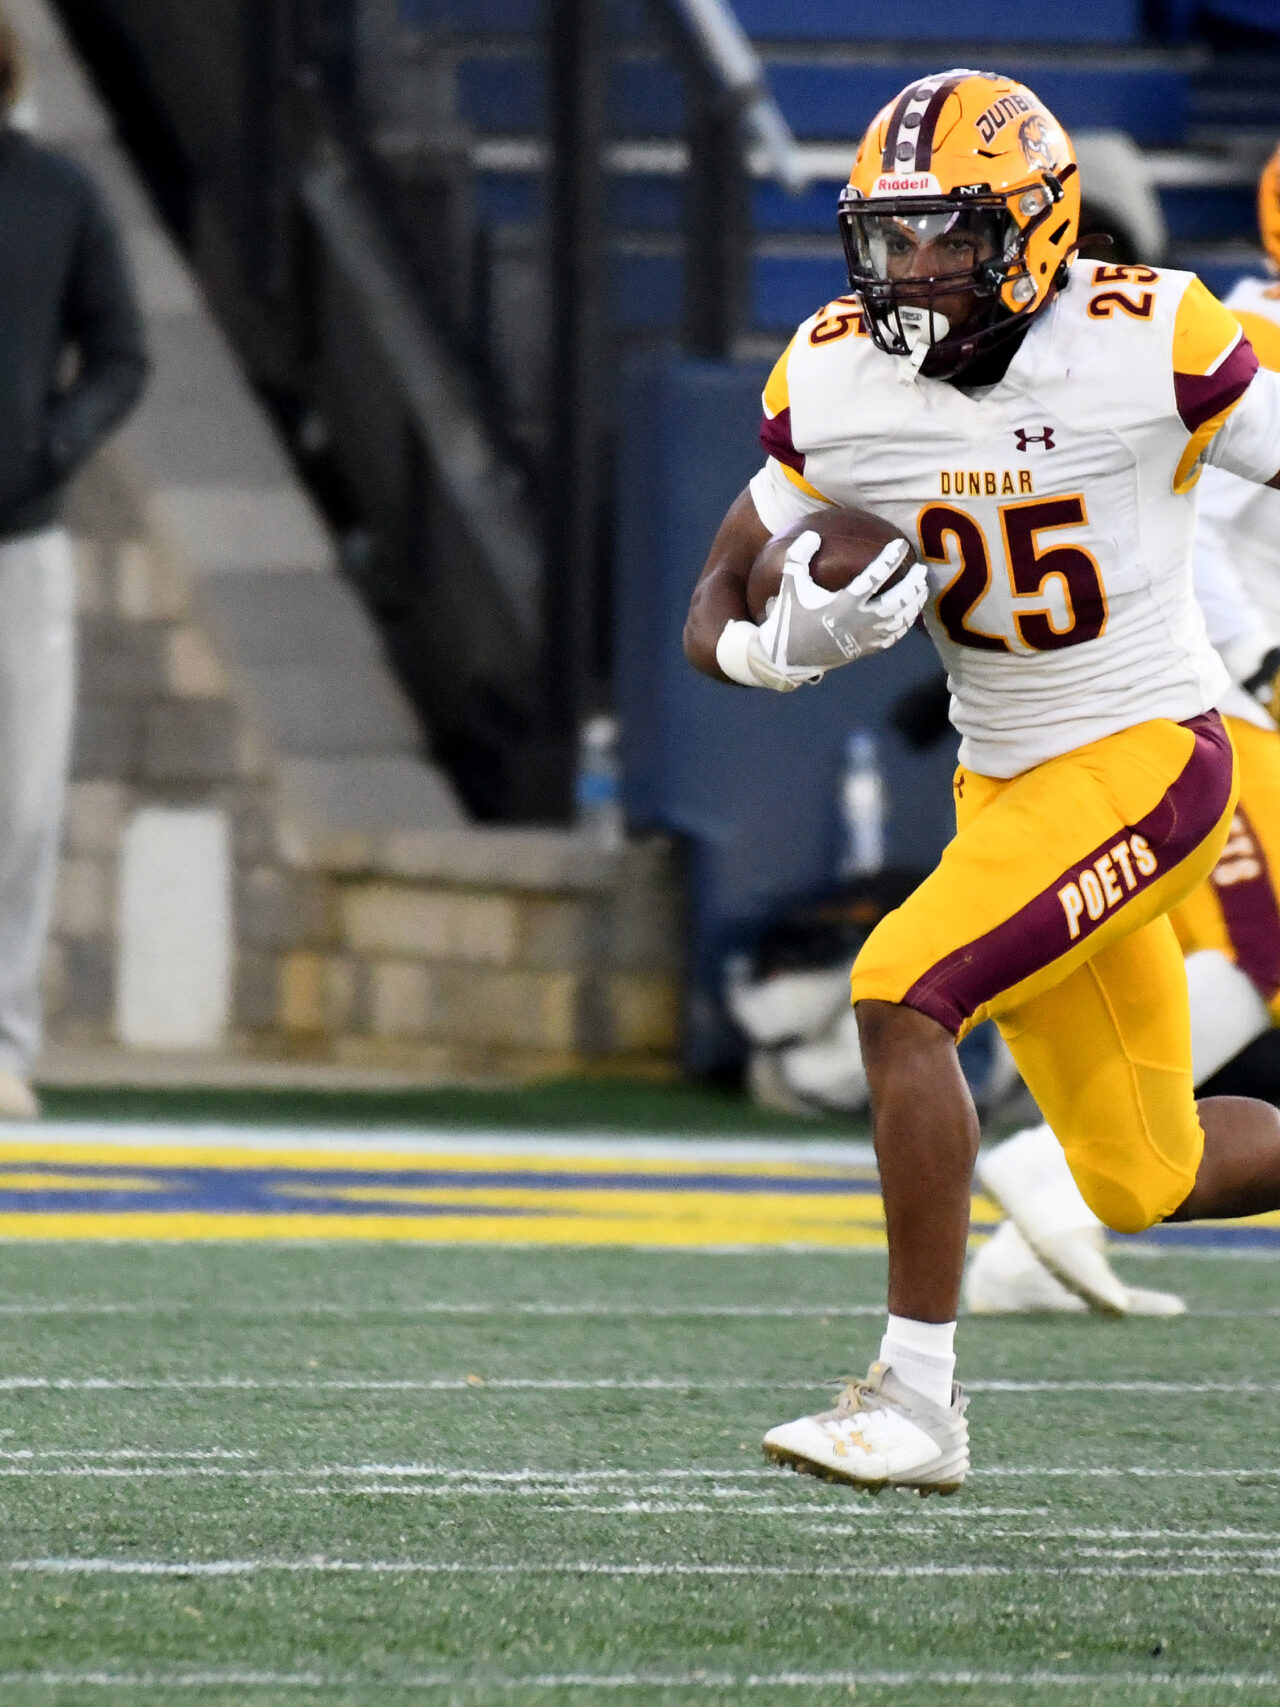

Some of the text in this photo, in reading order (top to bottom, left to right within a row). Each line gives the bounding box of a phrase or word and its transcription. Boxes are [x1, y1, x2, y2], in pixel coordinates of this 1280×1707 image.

[878, 177, 929, 191] Riddell
[1086, 264, 1161, 322] 25
[940, 470, 1034, 496] DUNBAR
[915, 493, 1110, 656] 25
[1057, 833, 1158, 940] POETS
